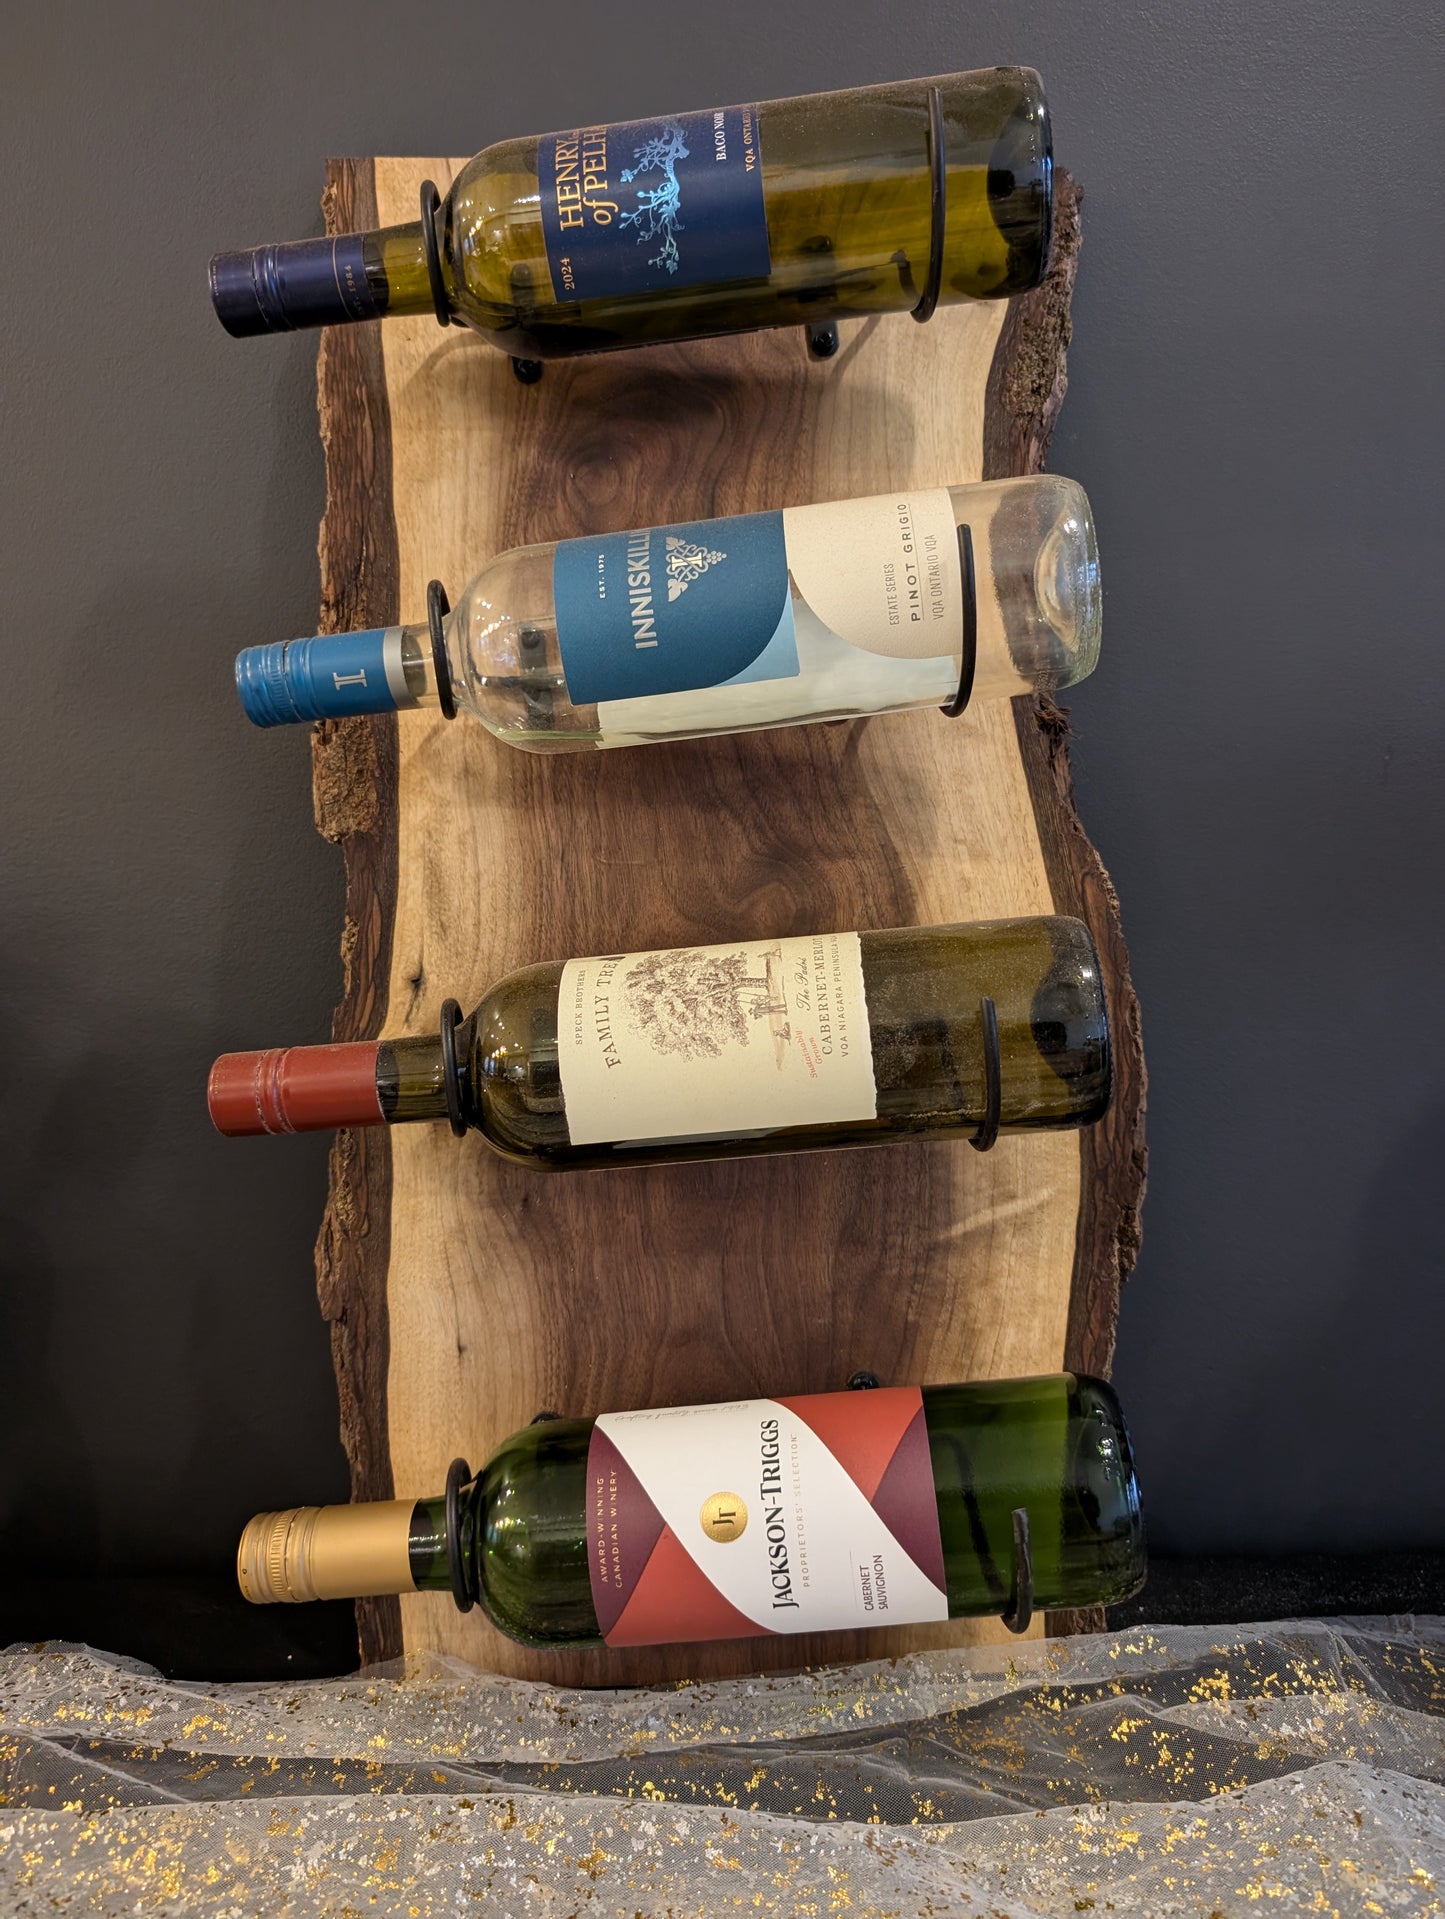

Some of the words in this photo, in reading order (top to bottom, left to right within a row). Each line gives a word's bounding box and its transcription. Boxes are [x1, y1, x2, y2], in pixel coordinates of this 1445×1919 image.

[582, 127, 608, 191] PELH
[715, 130, 727, 161] BACO
[745, 148, 756, 172] VQA
[555, 138, 585, 232] HENRY
[582, 196, 619, 226] of
[343, 264, 357, 293] 1984
[561, 257, 575, 290] 2024
[897, 503, 913, 553] GRIGIO
[924, 534, 937, 554] VQA
[598, 576, 606, 599] EST.
[883, 563, 897, 593] SERIES
[905, 563, 921, 622] PINOT
[926, 555, 943, 598] ONTARIO
[885, 593, 900, 626] ESTATE
[932, 601, 944, 620] VQA
[575, 969, 586, 1009] BROTHERS
[795, 989, 811, 1011] The
[835, 986, 846, 1032] NIAGARA
[575, 1012, 583, 1045] SPECK
[594, 995, 622, 1069] FAMILY
[840, 1037, 849, 1058] VQA
[795, 1030, 818, 1079] Sustainably
[609, 1470, 618, 1518] WINERY
[760, 1419, 800, 1609] JACKSON-TRIGGS
[596, 1477, 609, 1583] AWARD-WINNING
[712, 1507, 737, 1526] JT
[611, 1522, 623, 1588] CANADIAN
[795, 1502, 810, 1588] PROPRIETORS'
[859, 1564, 875, 1611] CABERNET
[872, 1554, 888, 1610] SAUVIGNON
